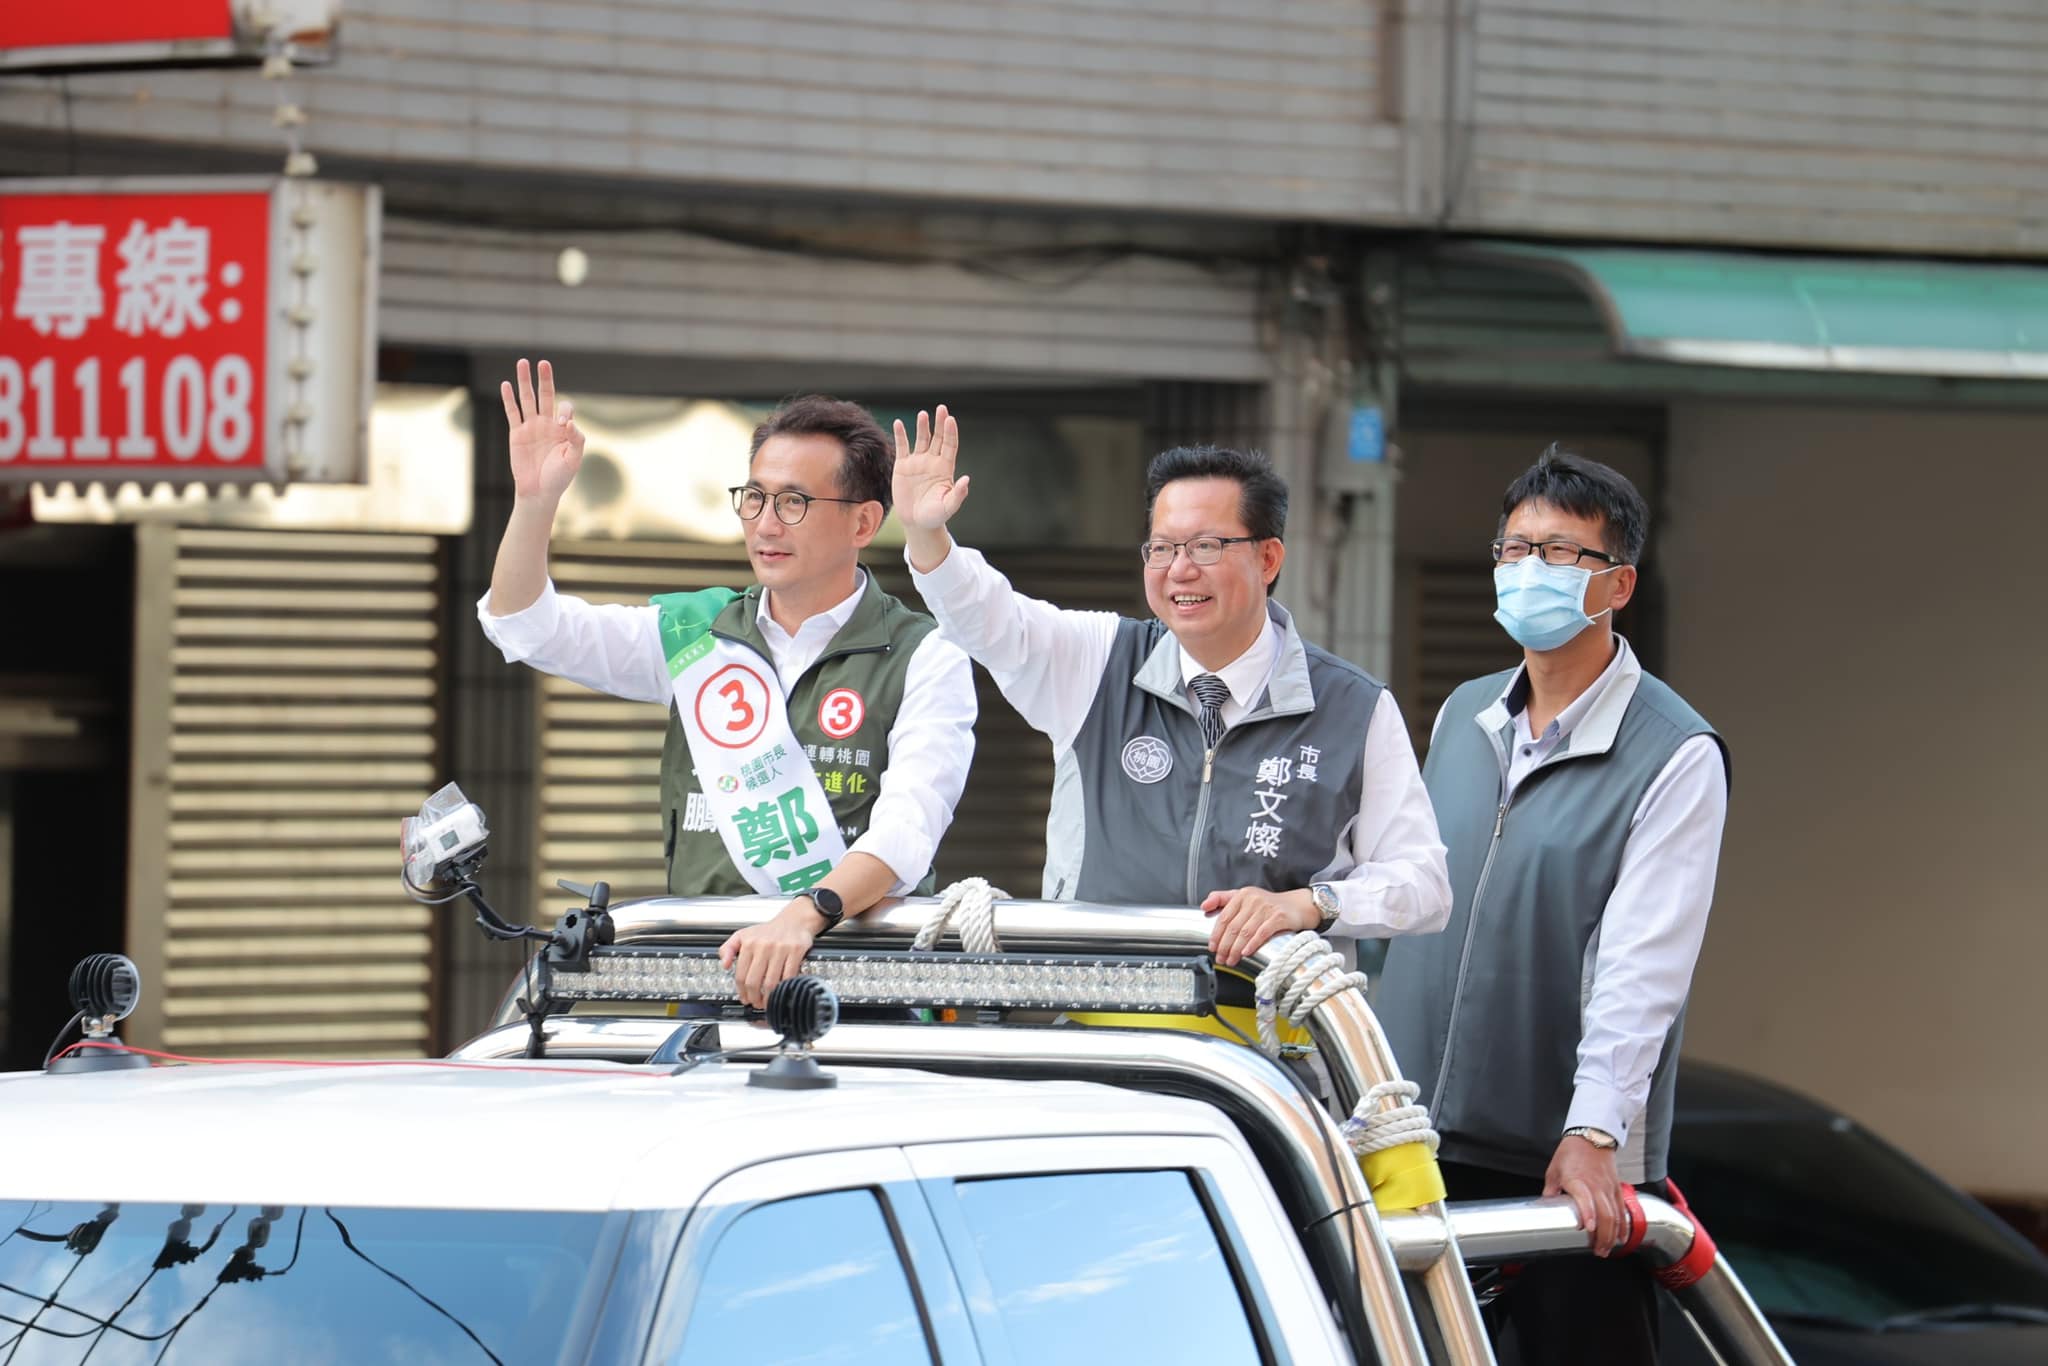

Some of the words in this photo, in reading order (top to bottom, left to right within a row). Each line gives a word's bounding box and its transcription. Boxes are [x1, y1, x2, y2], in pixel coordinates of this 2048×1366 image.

[0, 217, 243, 339] 專線:
[0, 353, 254, 461] 811108
[803, 744, 871, 767] 運轉桃園
[815, 770, 868, 794] 進化
[1296, 744, 1321, 783] 市長
[1243, 756, 1293, 858] 鄭文燦
